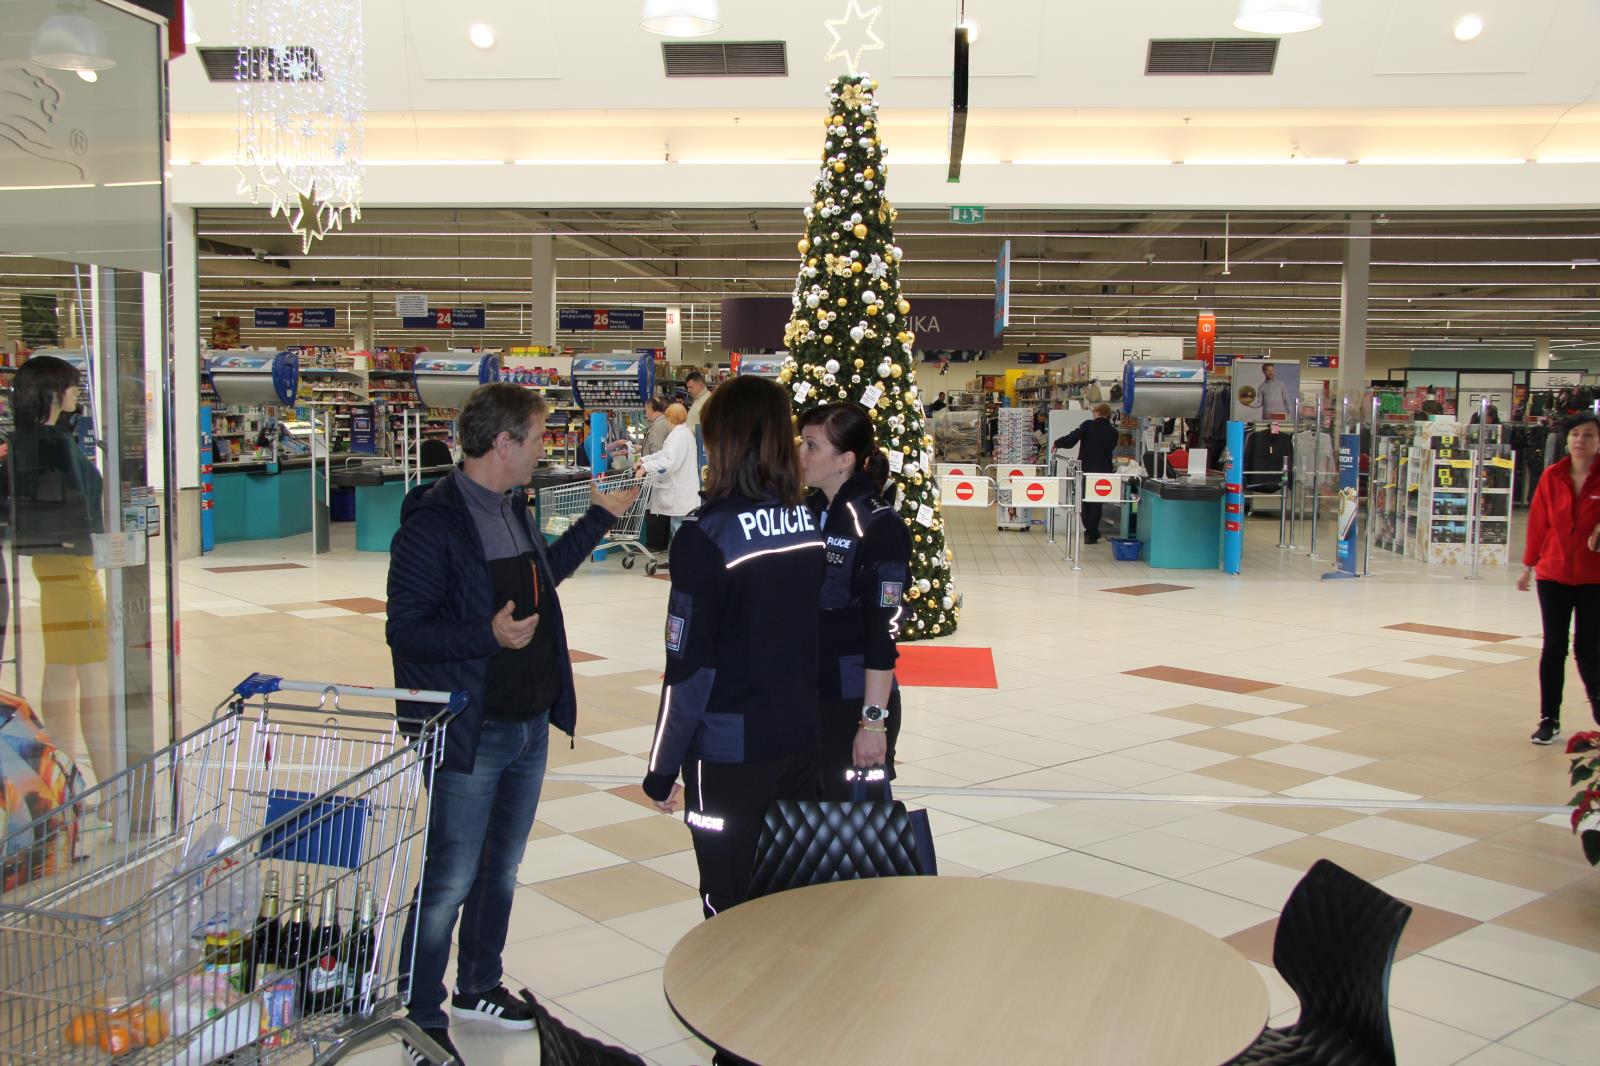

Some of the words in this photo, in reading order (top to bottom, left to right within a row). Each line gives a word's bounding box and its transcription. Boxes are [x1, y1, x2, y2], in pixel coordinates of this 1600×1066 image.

[289, 313, 303, 324] 25
[437, 313, 451, 324] 24
[594, 314, 608, 325] 26
[656, 350, 664, 358] 11
[1331, 358, 1337, 366] 4
[1469, 394, 1501, 408] FF
[738, 505, 815, 541] POLICIE
